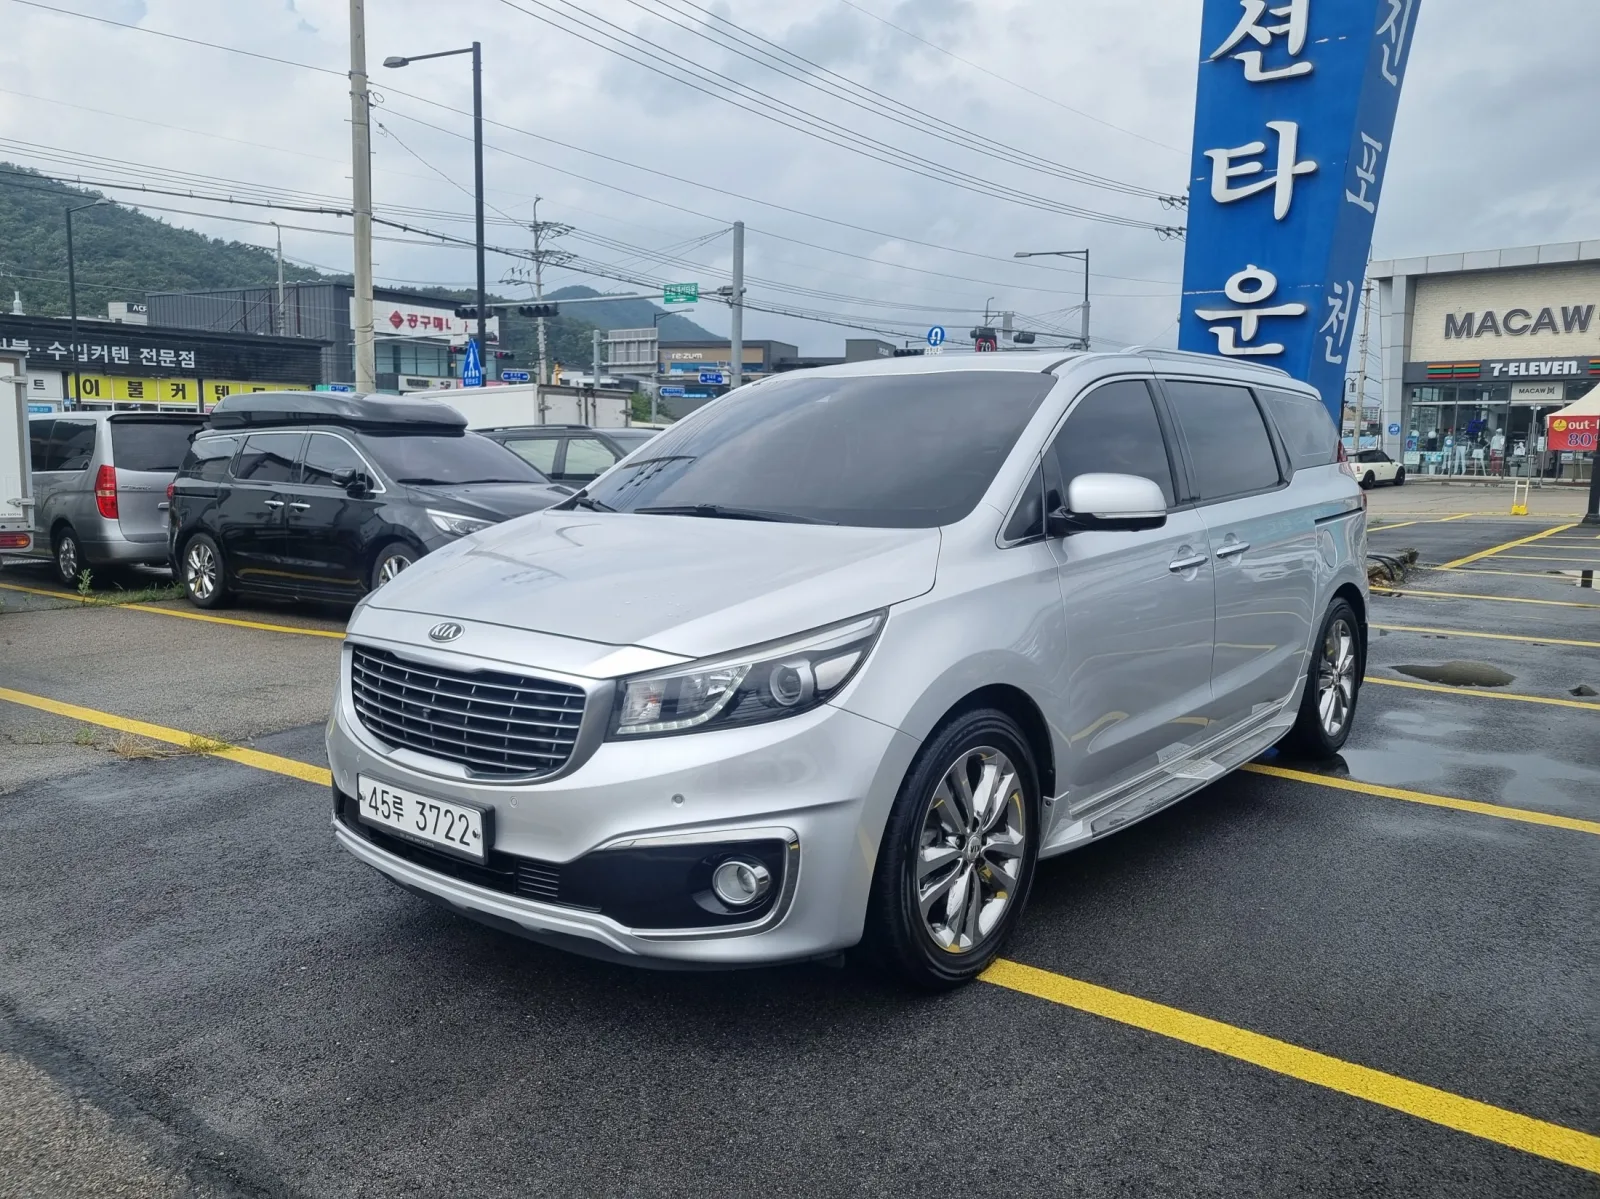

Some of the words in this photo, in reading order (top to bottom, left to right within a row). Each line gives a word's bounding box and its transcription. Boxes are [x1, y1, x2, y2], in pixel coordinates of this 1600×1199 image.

[1444, 304, 1596, 340] MACAW
[139, 347, 196, 369] 전문점
[979, 342, 992, 352] 70
[431, 624, 457, 638] KIA
[415, 800, 471, 847] 3722
